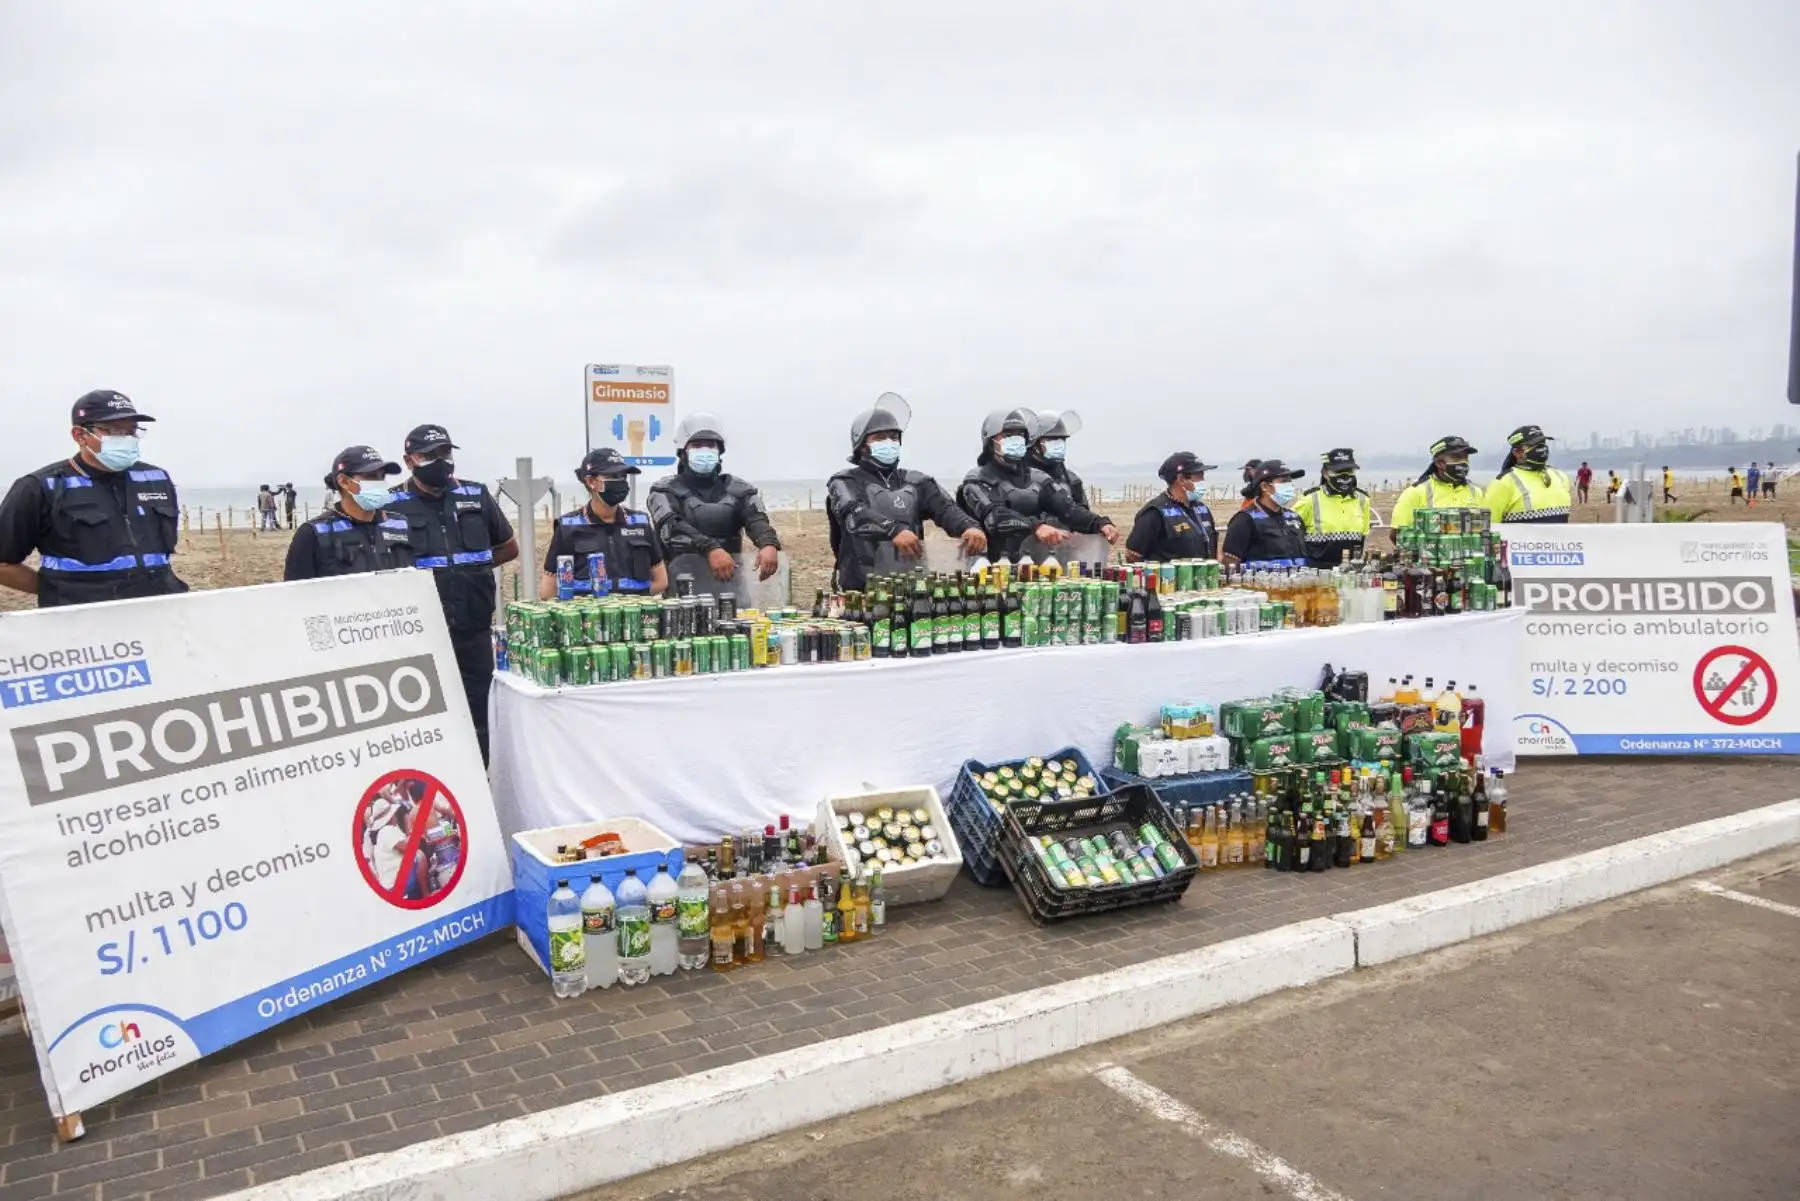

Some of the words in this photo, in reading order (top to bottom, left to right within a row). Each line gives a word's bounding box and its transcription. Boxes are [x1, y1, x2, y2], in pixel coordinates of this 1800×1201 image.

[595, 384, 667, 400] Gimnasio
[1510, 542, 1584, 551] CHORRILLOS
[1514, 554, 1534, 565] TE
[1536, 554, 1582, 565] CUIDA
[1523, 581, 1766, 613] PROHIBIDO
[337, 619, 424, 645] Chorrillos
[1526, 617, 1627, 636] comercio
[1633, 617, 1769, 636] ambulatorio
[0, 640, 144, 676] CHORRILLOS
[1530, 659, 1578, 673] multa
[1583, 662, 1592, 677] y
[1596, 658, 1679, 673] decomiso
[8, 678, 48, 703] TE
[55, 664, 145, 695] CUIDA
[33, 665, 432, 792] PROHIBIDO
[1620, 738, 1691, 749] Ordenanza
[1711, 738, 1782, 749] 372-MDCH
[56, 793, 171, 836] ingresar
[180, 781, 228, 805] con
[233, 749, 346, 792] alimentos
[350, 747, 362, 768] y
[366, 727, 444, 759] bebidas
[66, 813, 220, 869] alcohólicas
[85, 890, 175, 933] multa
[180, 881, 198, 907] y
[206, 842, 331, 894] decomiso
[257, 966, 367, 1019] Ordenanza
[397, 911, 485, 962] 372-MDCH
[79, 1034, 176, 1084] chorrillos
